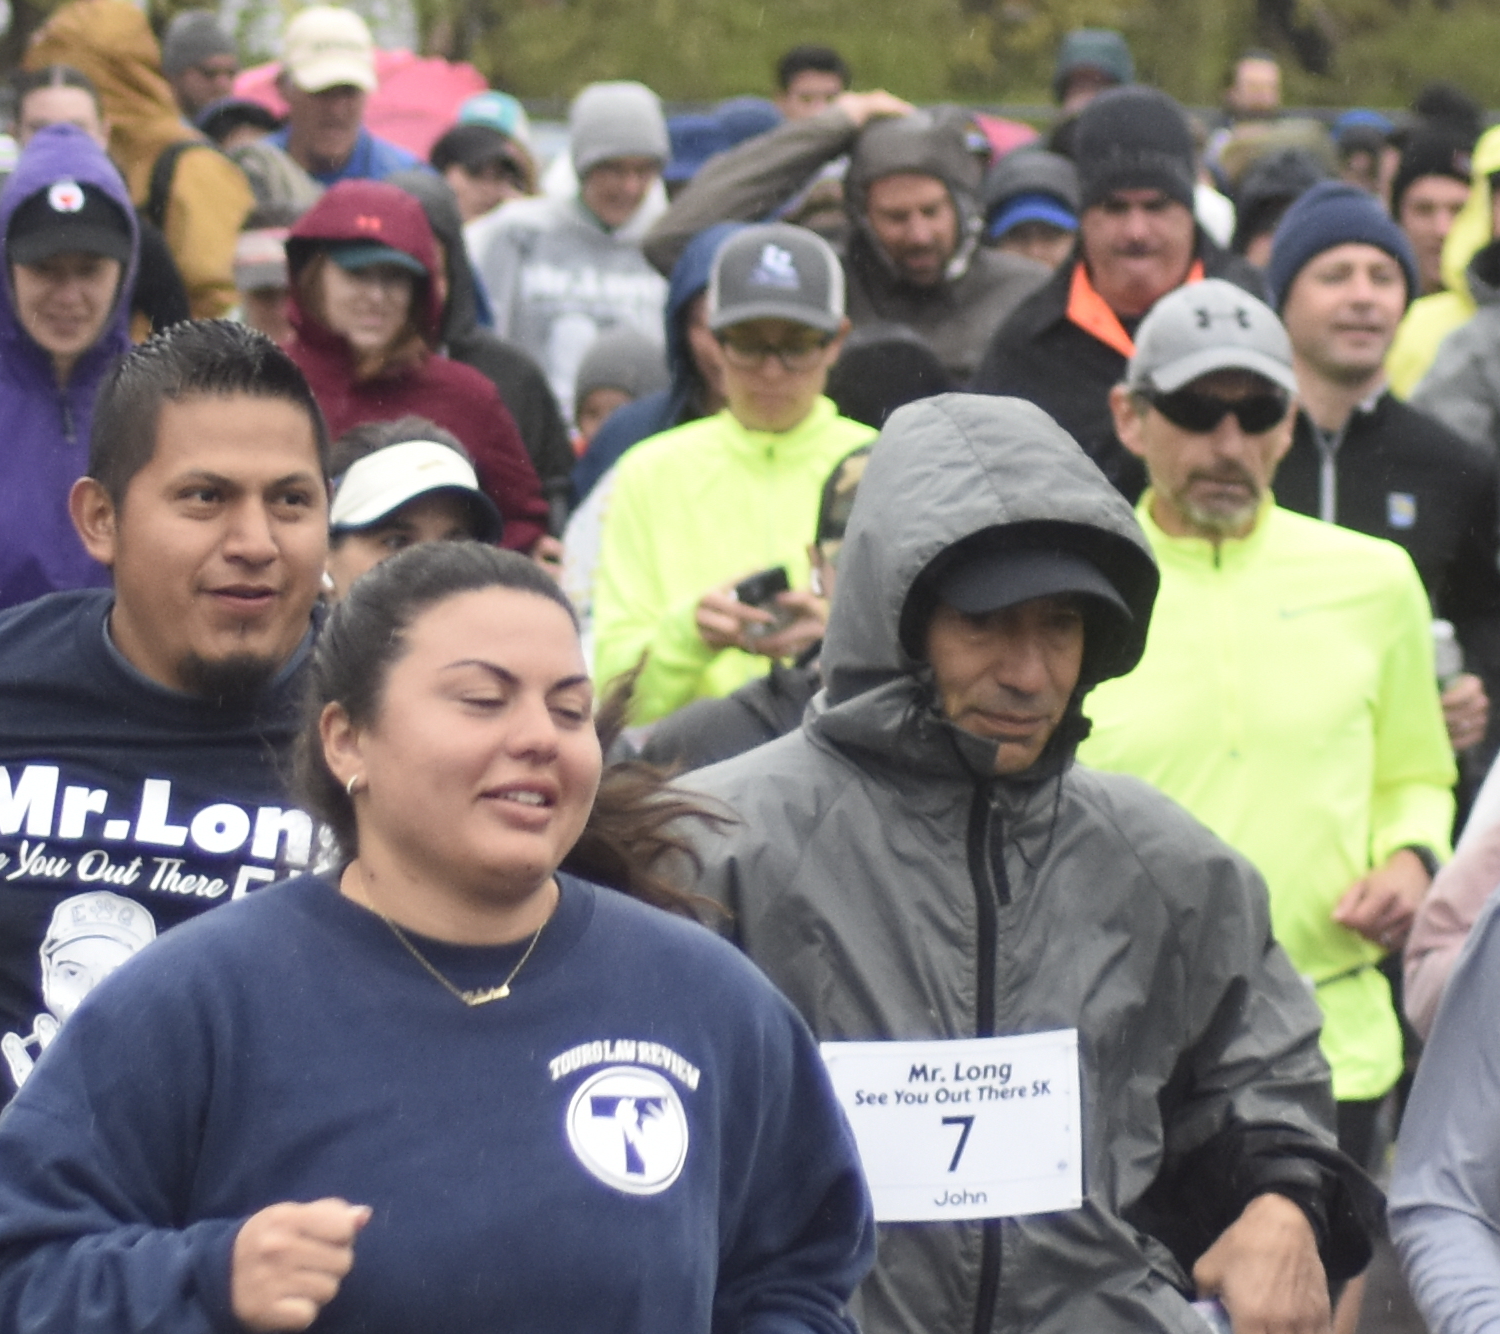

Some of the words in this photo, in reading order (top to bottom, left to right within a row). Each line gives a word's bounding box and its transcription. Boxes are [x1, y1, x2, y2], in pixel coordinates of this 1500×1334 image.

[6, 839, 71, 881] You
[77, 849, 143, 885] Out
[149, 857, 229, 899] There
[549, 1039, 603, 1081] TOURO
[603, 1038, 637, 1062] LAW
[637, 1040, 700, 1091] REVIEW
[908, 1063, 946, 1083] Mr.
[954, 1063, 1012, 1085] Long
[855, 1090, 888, 1106] See
[895, 1089, 928, 1104] You
[935, 1088, 971, 1104] Out
[978, 1085, 1027, 1101] There
[1032, 1080, 1051, 1096] 5K
[942, 1115, 976, 1172] 7
[934, 1189, 987, 1206] John
